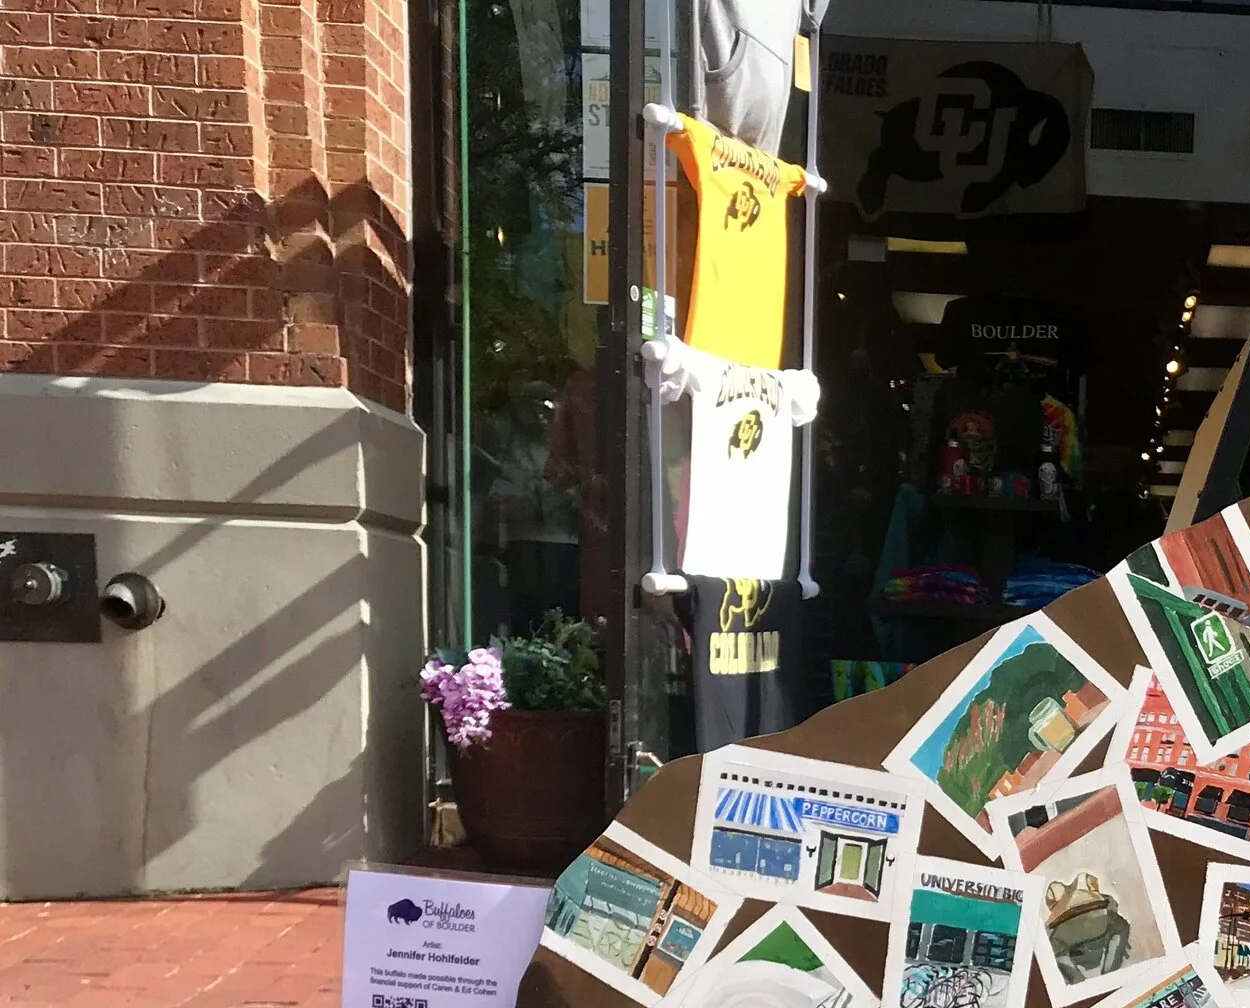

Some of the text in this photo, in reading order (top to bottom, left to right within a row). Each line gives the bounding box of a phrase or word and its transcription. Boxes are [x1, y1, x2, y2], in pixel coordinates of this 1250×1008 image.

[971, 324, 1059, 339] BOULDER
[709, 632, 780, 675] COLORADO
[802, 802, 888, 829] PEPPERCORN
[920, 873, 1001, 898] UNIVERSITY
[422, 900, 475, 922] Buffaloes
[422, 920, 475, 933] OF BOULDER
[422, 940, 442, 950] Artist:
[387, 949, 480, 966] Jennifer Hohlfelder
[370, 967, 498, 987] This buffalo made possible through the
[370, 977, 396, 986] financial
[397, 980, 422, 990] support
[423, 982, 431, 990] of
[432, 983, 452, 992] Caren
[454, 985, 460, 993] &
[462, 985, 472, 994] Ed
